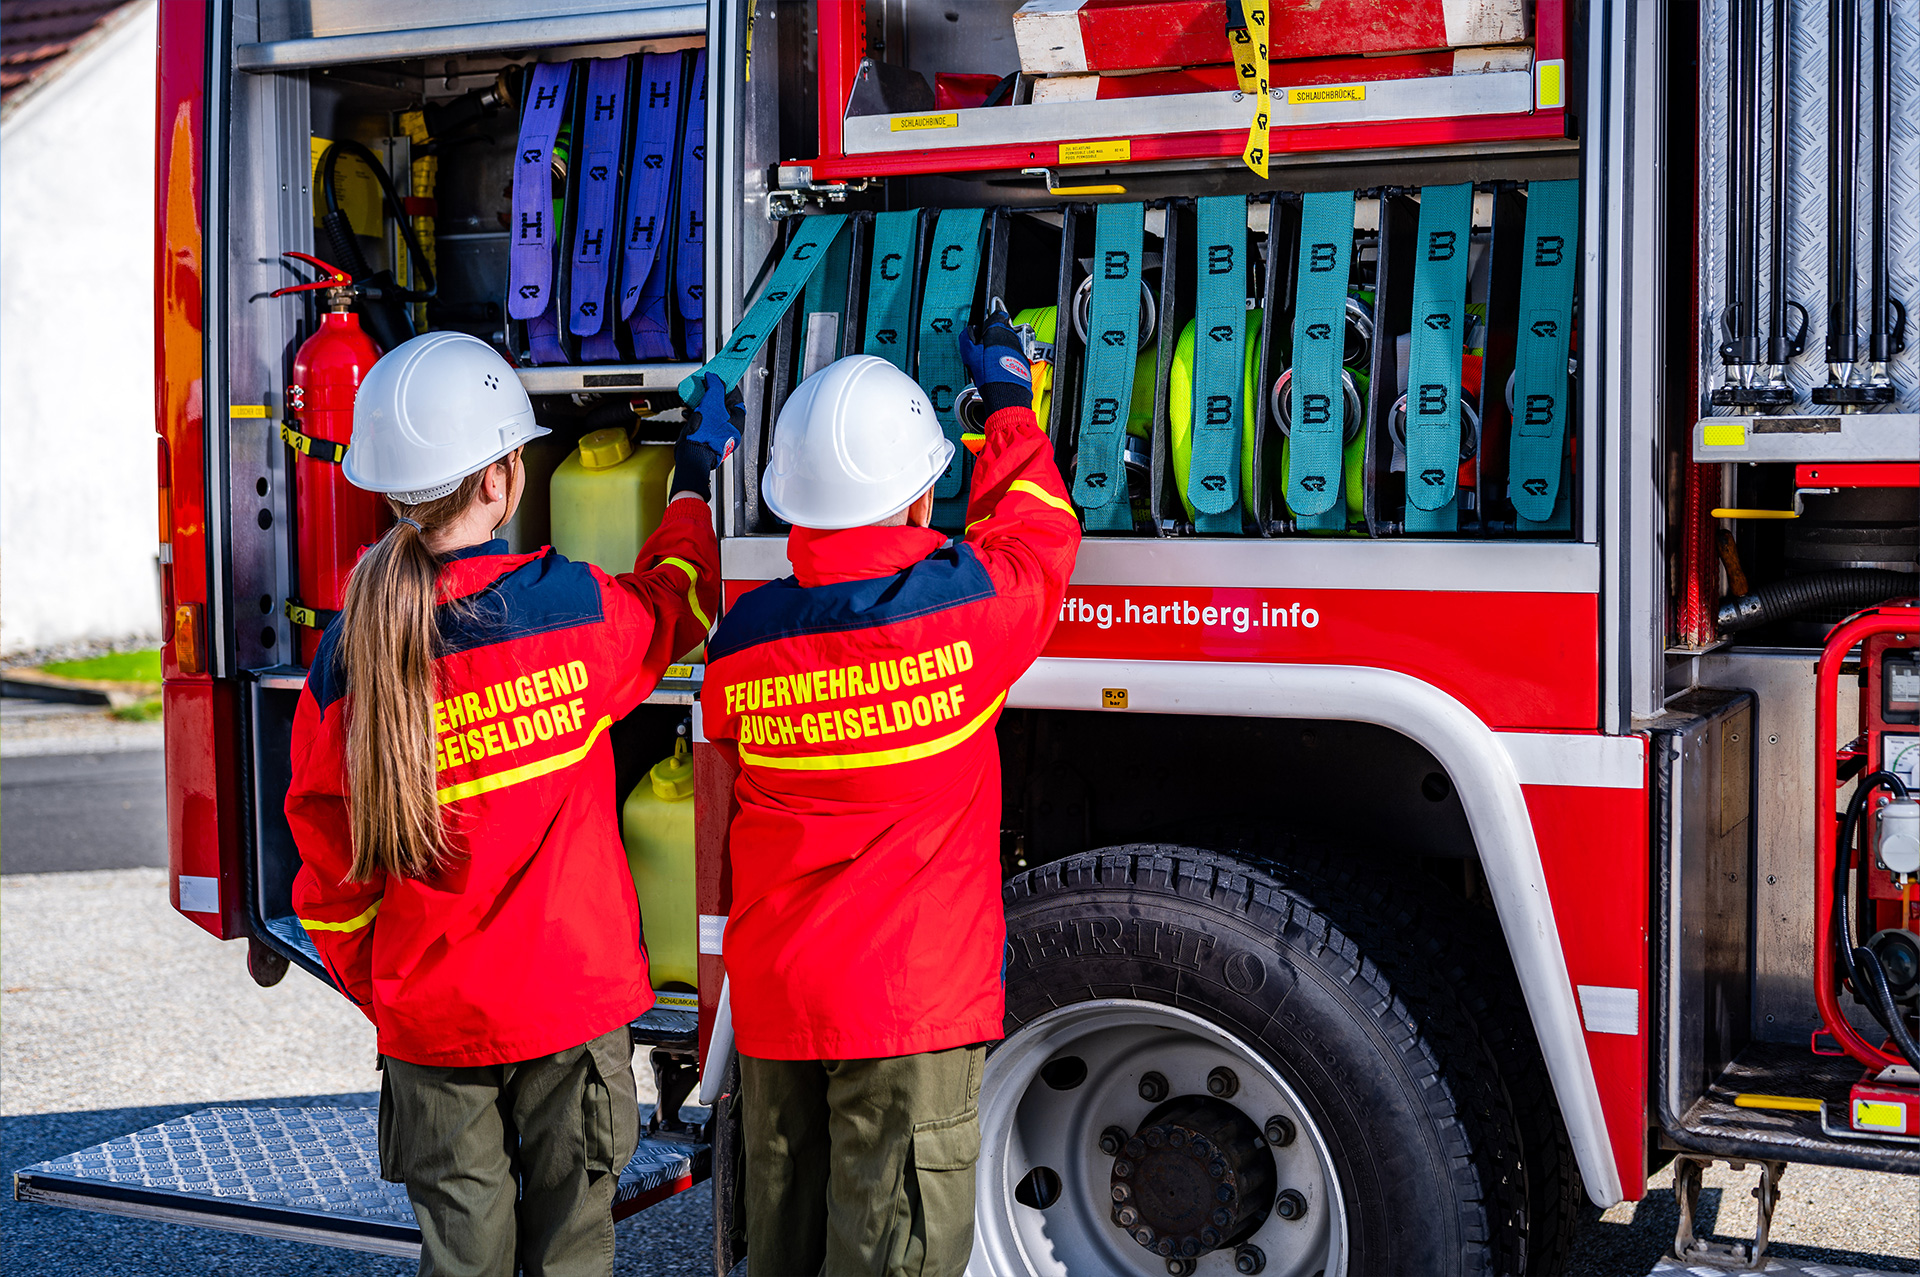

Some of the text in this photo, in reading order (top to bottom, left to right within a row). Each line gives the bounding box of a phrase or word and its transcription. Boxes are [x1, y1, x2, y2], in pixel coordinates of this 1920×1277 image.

[534, 85, 559, 110] H
[594, 94, 616, 121] H
[650, 81, 671, 108] H
[1296, 89, 1355, 101] SCHLAUCHBRÜCKE
[900, 117, 946, 128] SCHLAUCHBINDE
[521, 212, 542, 238] H
[631, 216, 655, 242] H
[582, 228, 604, 255] H
[792, 242, 817, 261] C
[1428, 230, 1457, 262] B
[1535, 235, 1565, 267] B
[880, 253, 902, 281] C
[941, 244, 964, 271] C
[1105, 250, 1130, 280] B
[1208, 244, 1234, 275] B
[1310, 243, 1337, 273] B
[732, 334, 757, 353] C
[931, 384, 953, 412] C
[1091, 398, 1119, 426] B
[1206, 394, 1232, 425] B
[1303, 394, 1331, 425] B
[1419, 383, 1448, 416] B
[1524, 394, 1555, 426] B
[724, 640, 974, 715] FEUERWEHRJUGEND
[740, 684, 965, 745] BUCH-GEISELDORF
